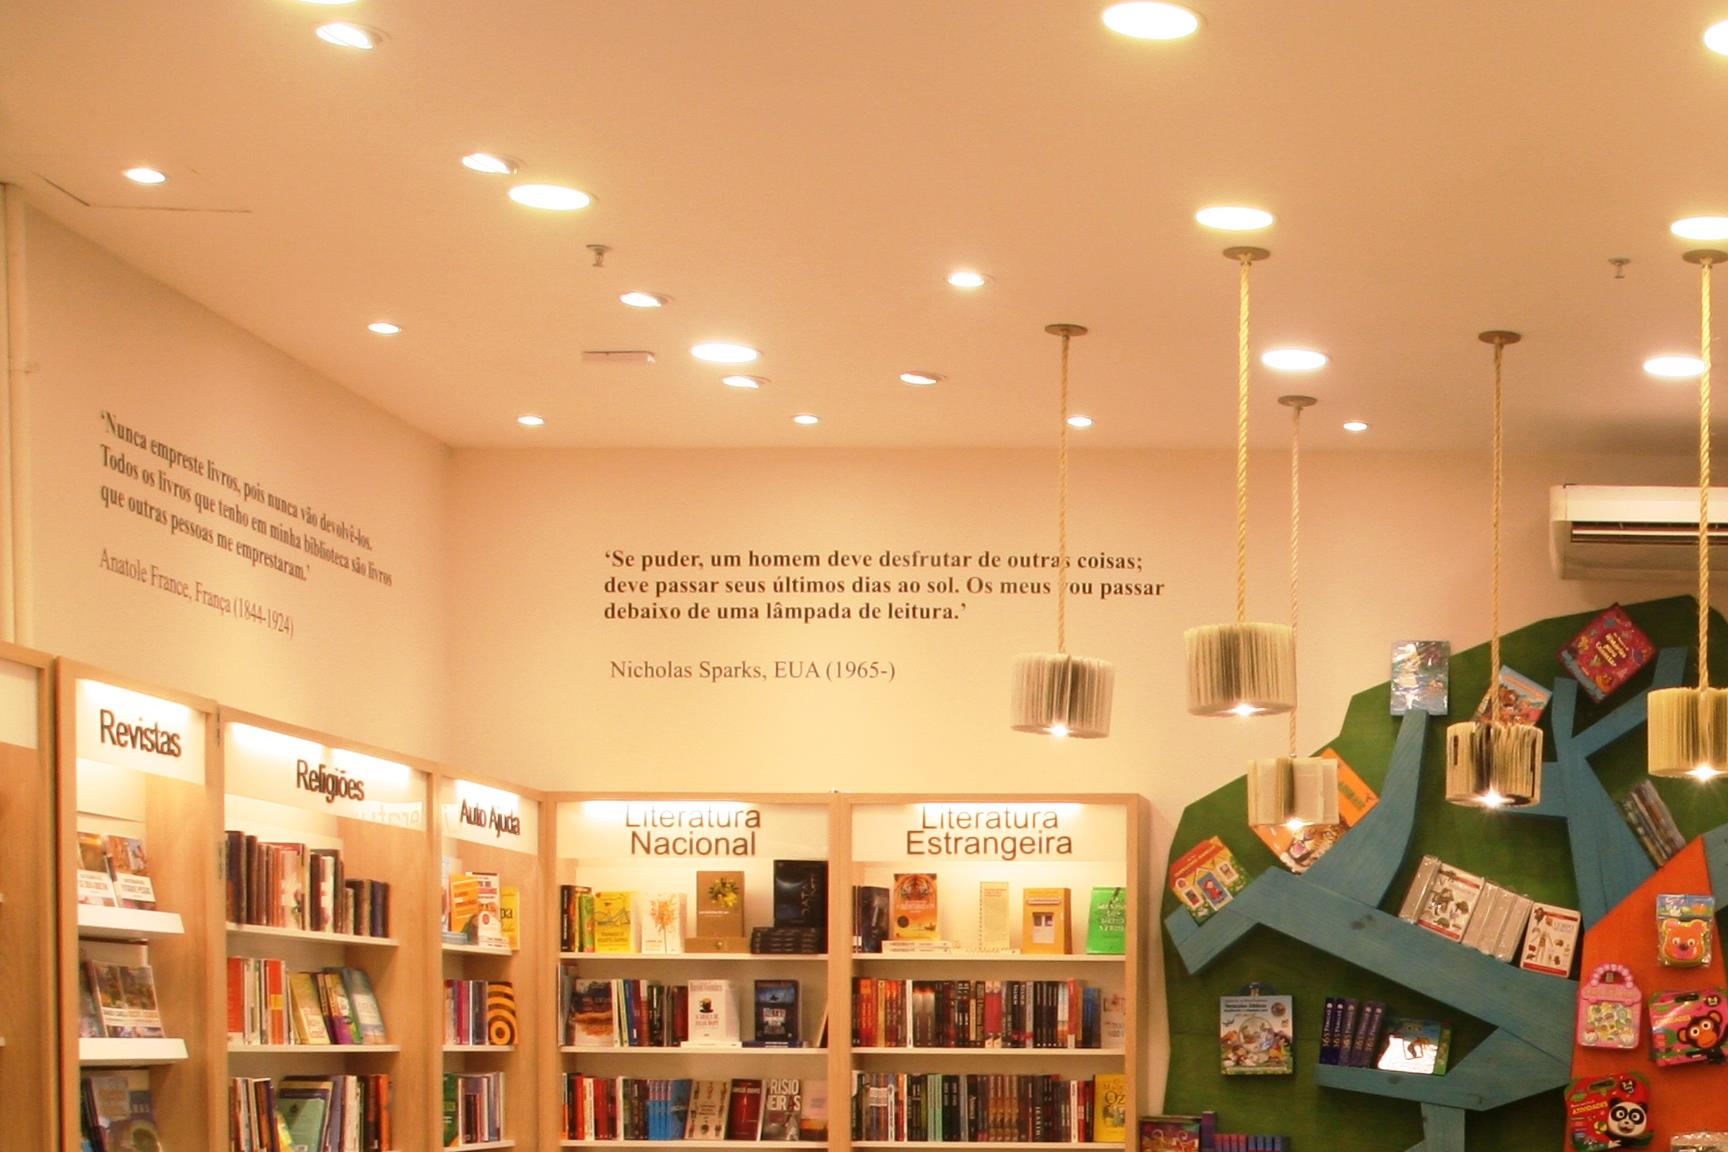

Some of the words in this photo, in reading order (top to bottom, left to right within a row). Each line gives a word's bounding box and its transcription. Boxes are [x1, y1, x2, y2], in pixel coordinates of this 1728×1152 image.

[150, 439, 204, 477] empreste
[207, 459, 241, 494] livros,
[244, 481, 265, 504] pois
[268, 492, 298, 518] nunca
[301, 506, 318, 527] vão
[320, 513, 373, 550] devolvê-los.
[100, 443, 139, 480] Todos
[142, 468, 155, 487] os
[158, 469, 192, 502] livros
[194, 491, 216, 514] que
[219, 499, 249, 527] tenho
[251, 516, 267, 535] em
[270, 522, 301, 549] minha
[304, 533, 350, 569] biblioteca
[351, 557, 366, 577] são
[368, 561, 393, 587] livros
[100, 485, 125, 509] que
[128, 496, 168, 526] outras
[171, 514, 214, 545] pessoas
[217, 532, 233, 551] me
[641, 550, 705, 572] puder,
[710, 554, 741, 567] um
[749, 550, 821, 567] homem
[828, 550, 872, 567] deve
[879, 550, 972, 568] desfrutar
[978, 551, 1001, 568] de
[1077, 552, 1143, 572] coisas;
[100, 547, 148, 584] Anatole
[150, 565, 193, 602] France,
[195, 581, 232, 616] França
[233, 596, 295, 640] (1844-1924)
[604, 576, 649, 593] deve
[655, 580, 720, 598] passar
[725, 580, 766, 593] seus
[772, 575, 845, 593] últimos
[852, 576, 892, 593] dias
[898, 580, 920, 594] ao
[927, 577, 960, 594] sol.
[966, 576, 993, 594] Os
[1000, 580, 1051, 594] meus
[1059, 581, 1093, 595] ou
[1100, 580, 1165, 599] passar
[604, 602, 681, 619] debaixo
[688, 602, 711, 619] de
[717, 606, 759, 619] uma
[766, 602, 852, 624] lâmpada
[859, 602, 881, 619] de
[610, 660, 693, 678] Nicholas
[699, 660, 767, 682] Sparks,
[774, 661, 821, 678] EUA
[825, 660, 896, 682] (1965-)
[100, 709, 182, 758] Revistas
[296, 759, 365, 804] Religiões
[460, 798, 487, 828] Auto
[489, 805, 521, 838] Ajuda
[625, 804, 762, 829] Literatura
[921, 805, 1059, 830] Literatura
[630, 830, 756, 856] Nacional
[905, 830, 1074, 860] Estrangeira
